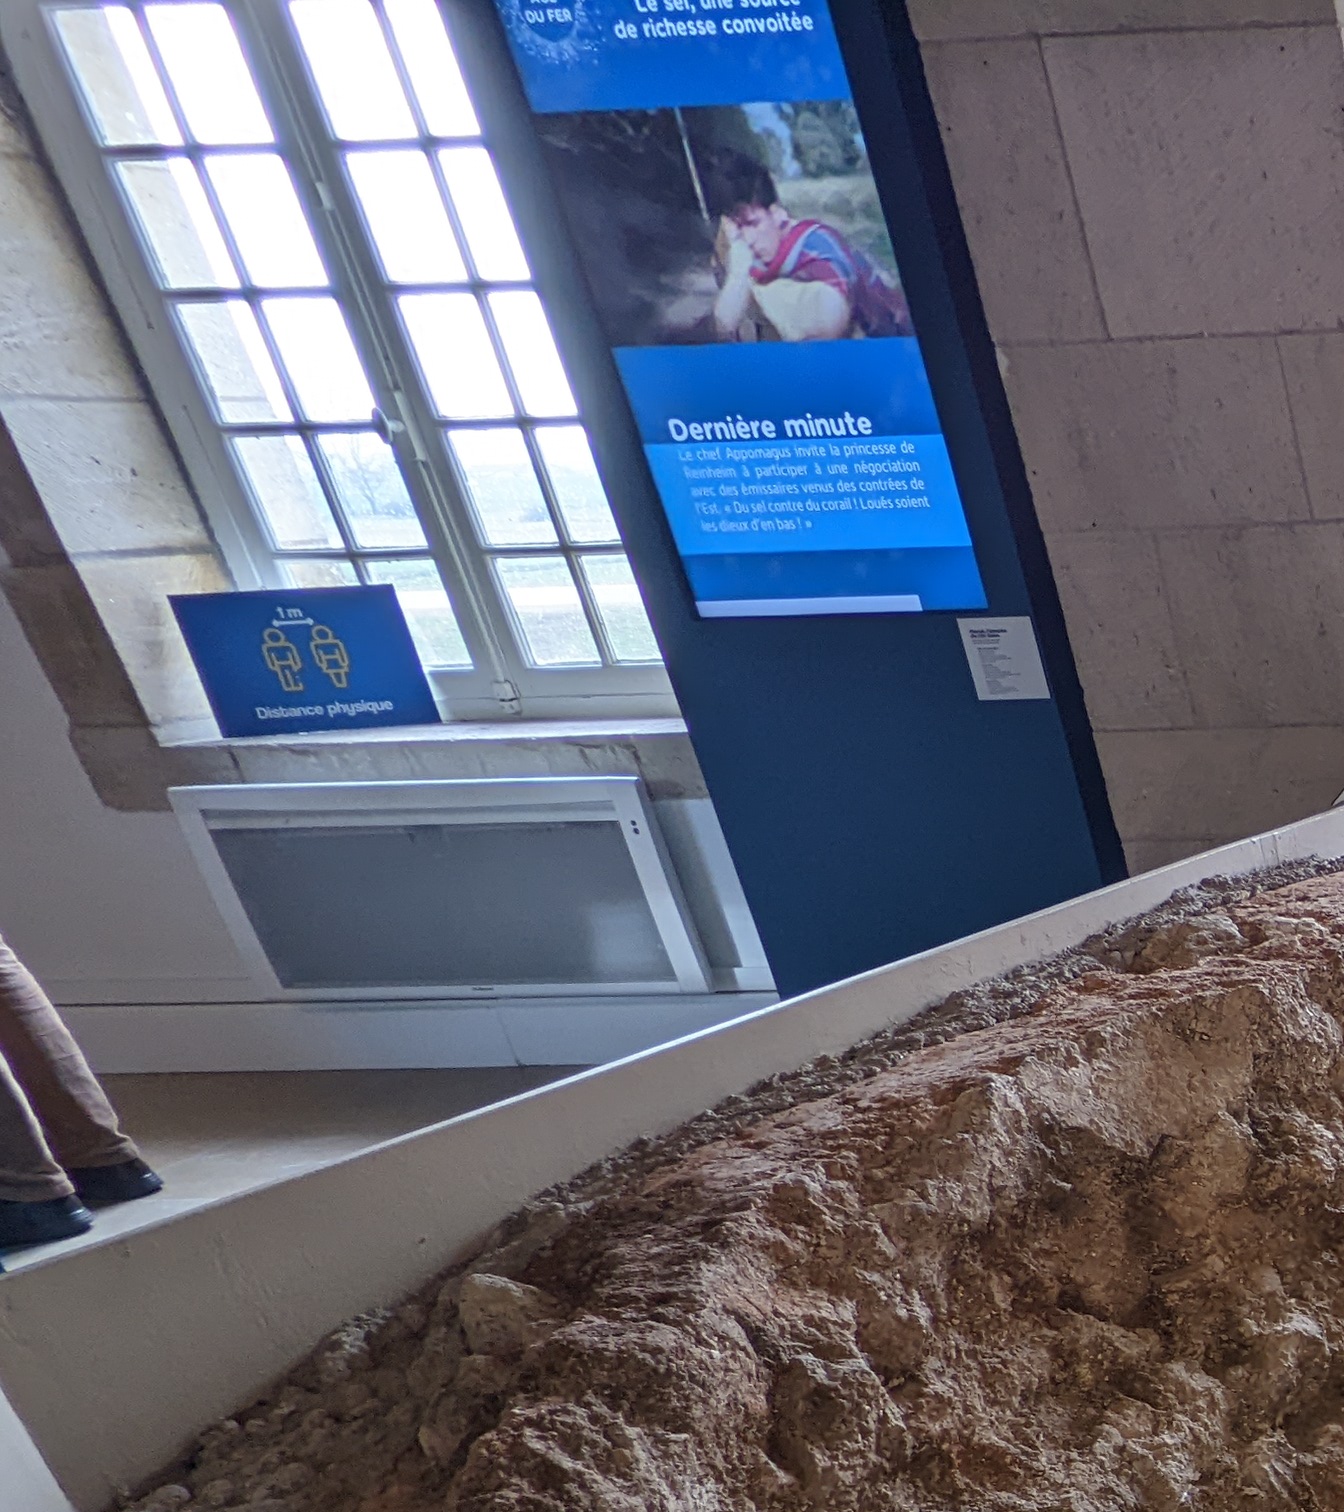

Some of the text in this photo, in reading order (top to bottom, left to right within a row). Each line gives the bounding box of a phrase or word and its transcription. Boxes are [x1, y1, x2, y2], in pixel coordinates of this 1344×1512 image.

[635, 0, 658, 12] Le
[525, 8, 573, 24] DU FER
[614, 11, 814, 39] de richesse convoitée
[668, 411, 873, 442] Dernière minute
[696, 446, 721, 461] chef
[726, 446, 792, 462] Appomagus
[795, 445, 827, 458] invite
[829, 443, 840, 458] la
[844, 442, 897, 458] princesse
[901, 440, 915, 454] de
[754, 463, 808, 479] participer
[814, 462, 822, 475] à
[827, 463, 848, 475] une
[854, 459, 921, 476] négociation
[718, 483, 739, 496] des
[741, 481, 799, 496] émissaires
[801, 481, 834, 494] venus
[836, 479, 857, 492] des
[859, 477, 908, 492] contrées
[910, 476, 925, 490] de
[751, 500, 767, 513] sel
[768, 500, 805, 513] contre
[806, 499, 820, 512] du
[822, 497, 852, 511] corail
[860, 496, 894, 511] Loués
[895, 494, 931, 509] soient
[777, 518, 797, 531] bas
[255, 700, 394, 719] Distance physique
